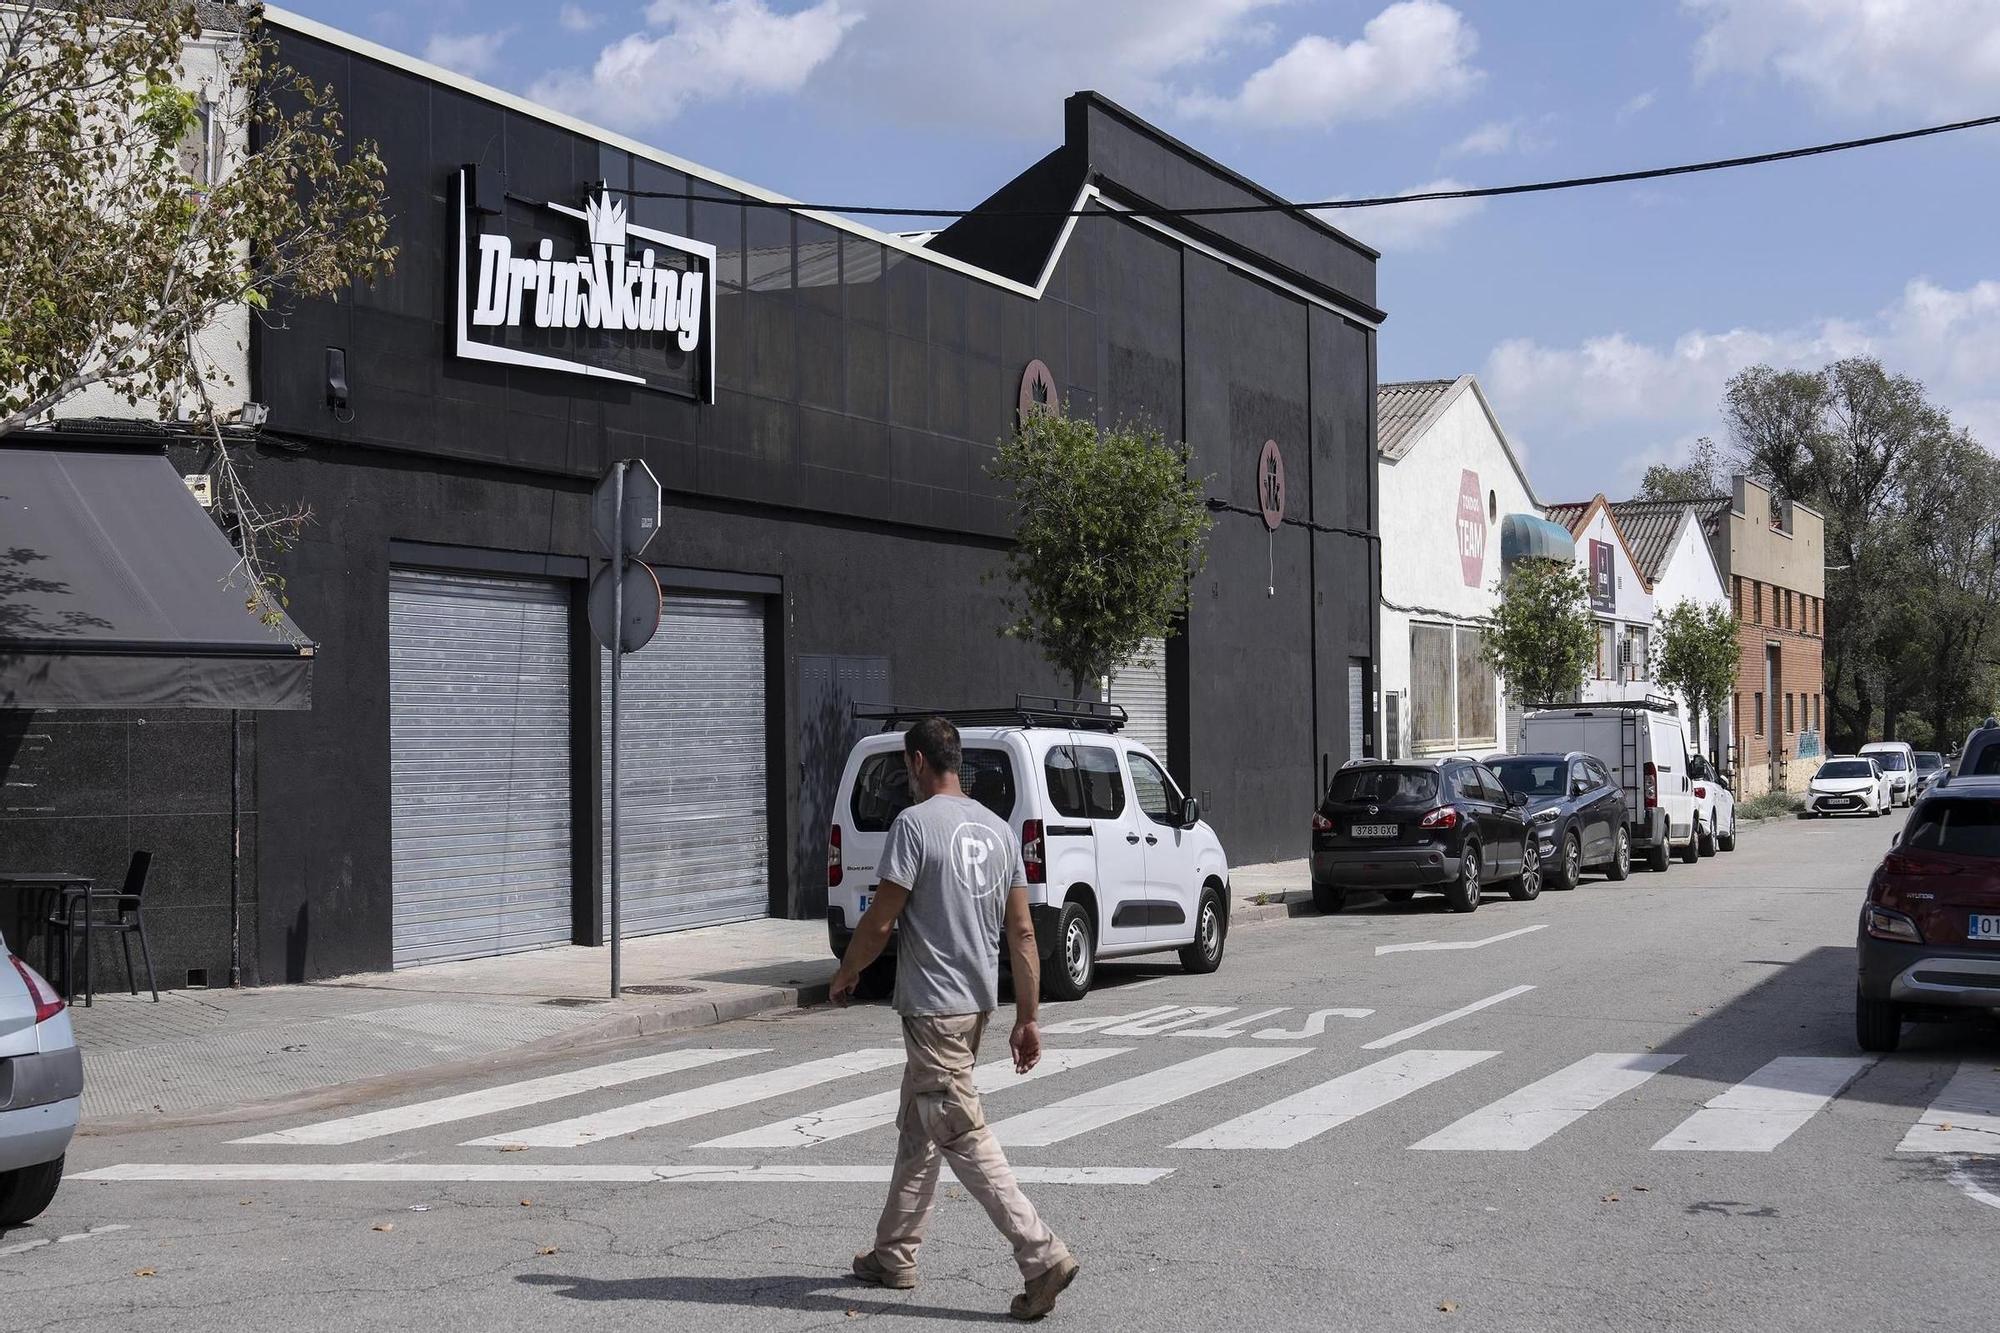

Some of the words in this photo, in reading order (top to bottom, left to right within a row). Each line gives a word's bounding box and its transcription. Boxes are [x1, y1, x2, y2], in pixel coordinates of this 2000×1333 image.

[1459, 519, 1483, 560] TEAM
[1356, 826, 1378, 835] 3783
[1380, 825, 1397, 835] GXC
